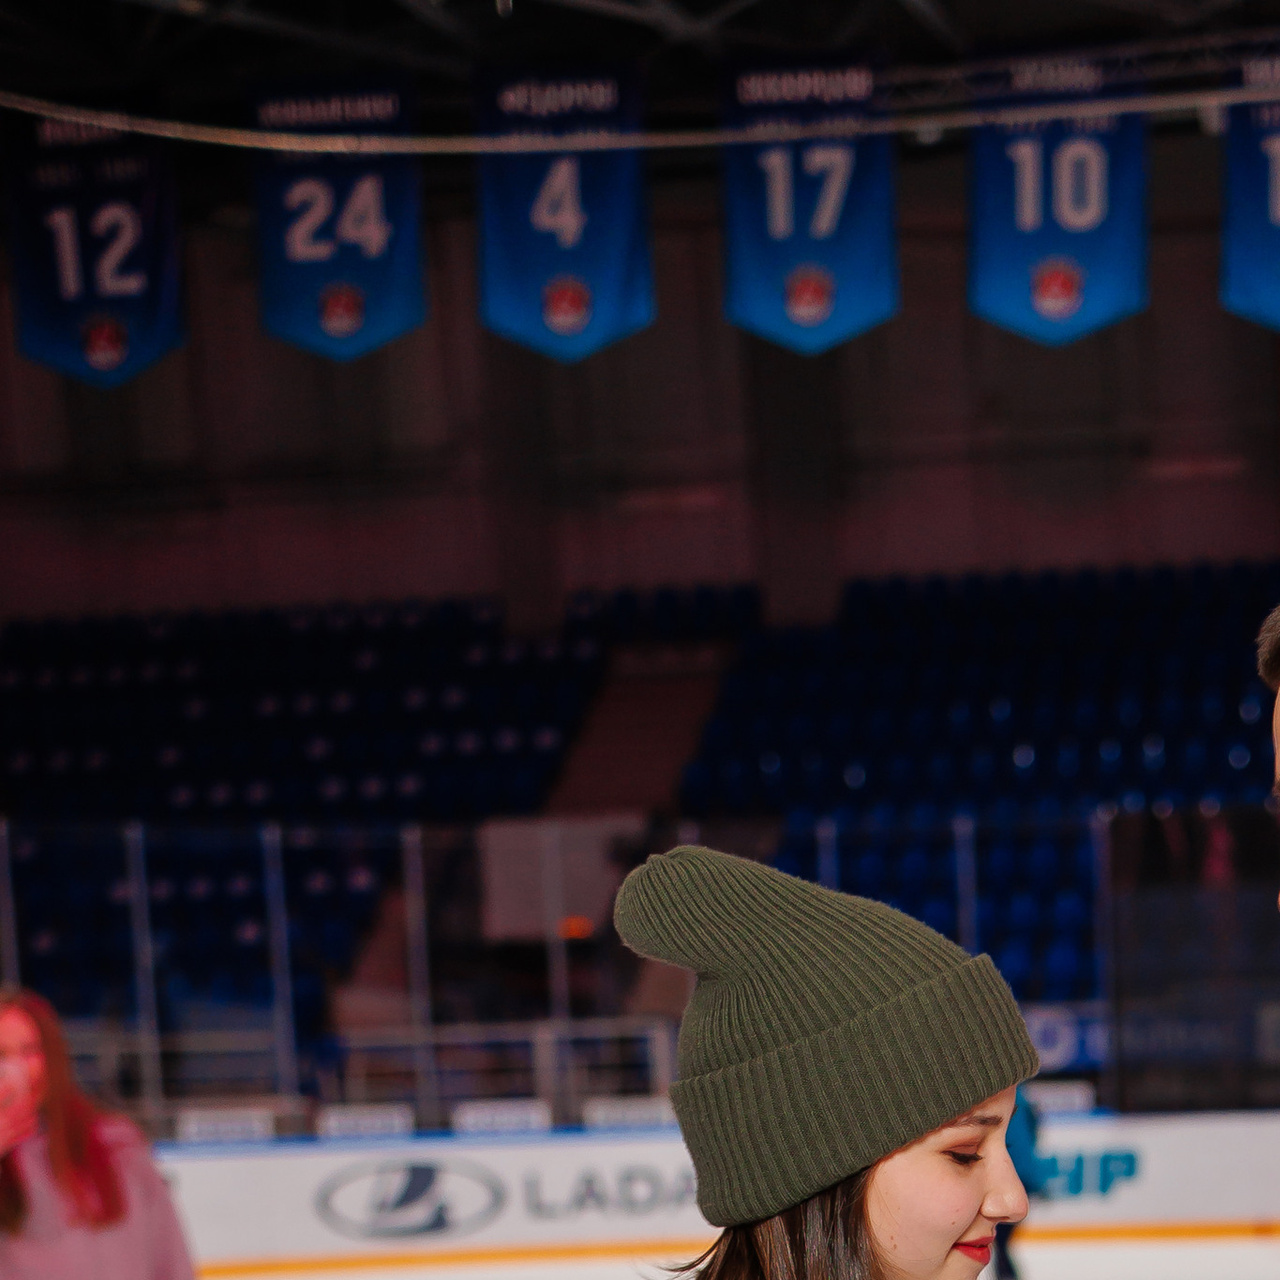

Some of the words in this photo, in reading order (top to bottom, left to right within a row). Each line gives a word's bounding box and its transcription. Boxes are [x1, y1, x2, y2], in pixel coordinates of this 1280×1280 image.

[283, 172, 395, 263] 24
[530, 155, 590, 250] 4
[757, 144, 858, 241] 17
[1005, 136, 1110, 235] 10
[44, 202, 150, 300] 12
